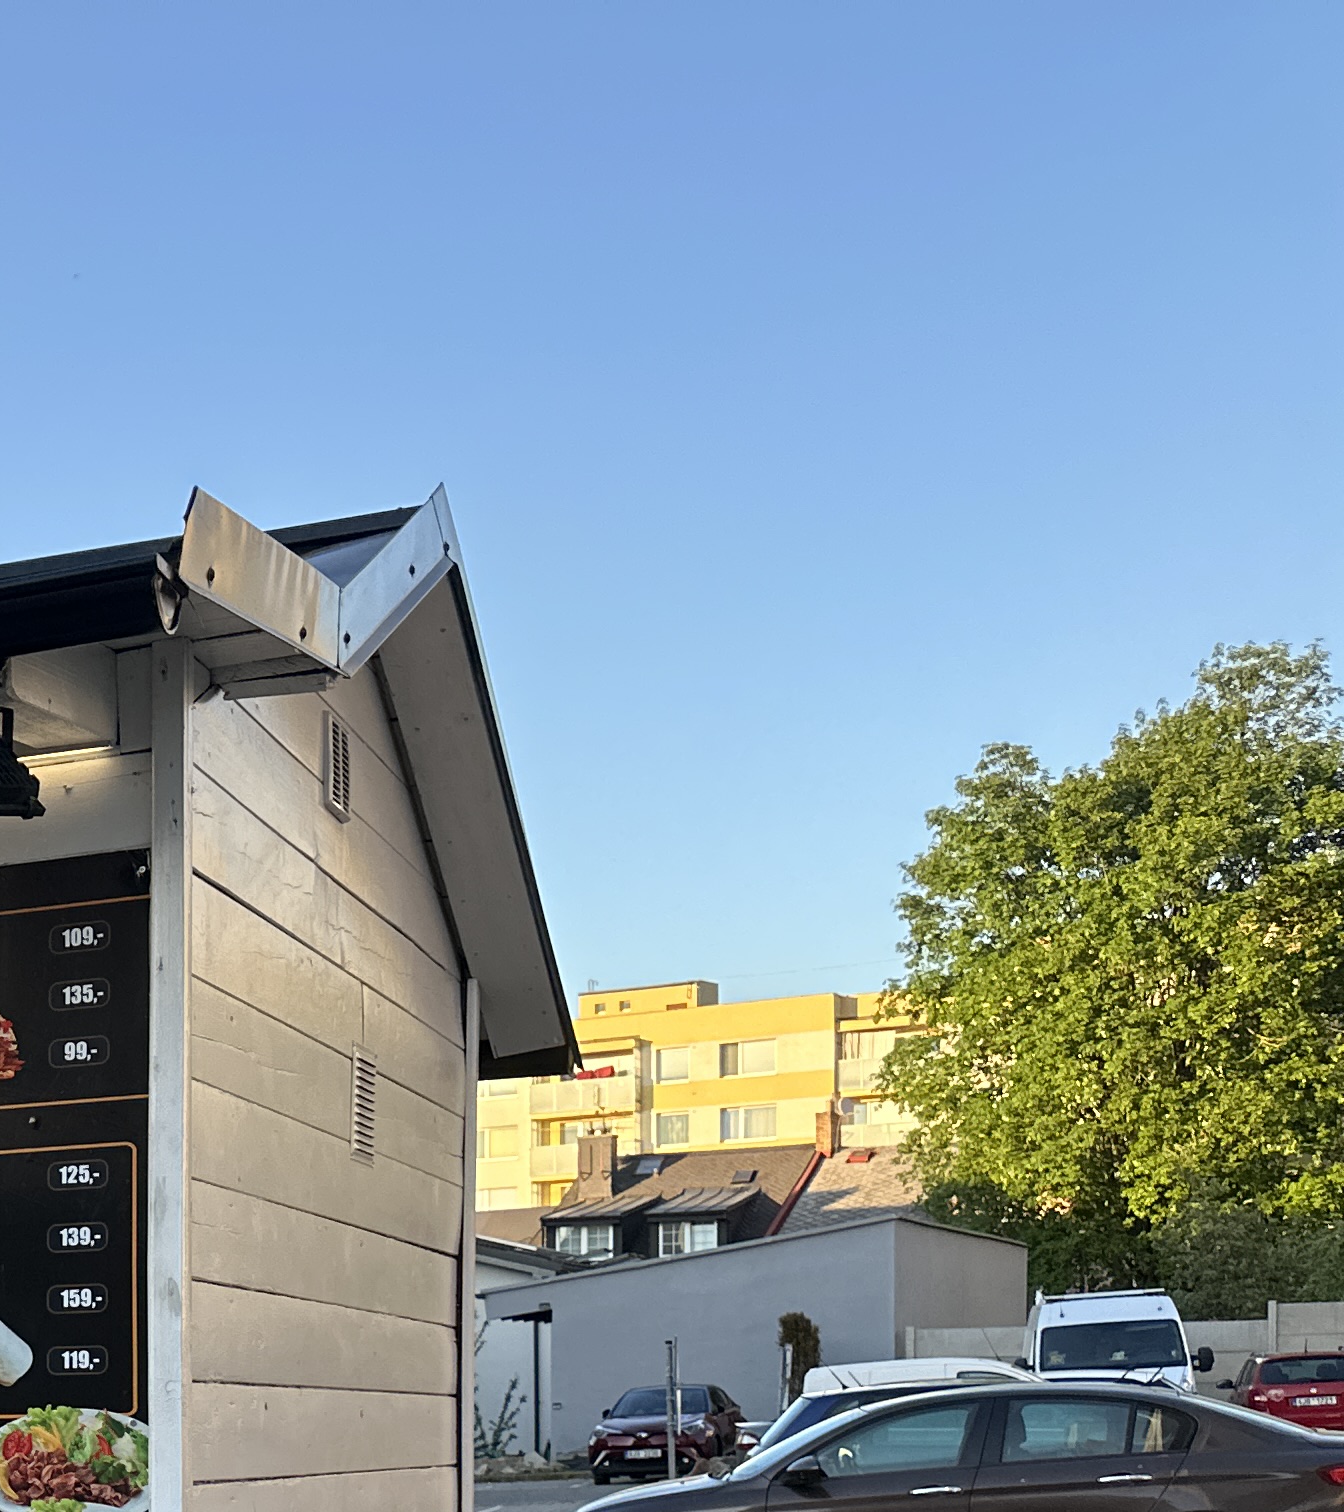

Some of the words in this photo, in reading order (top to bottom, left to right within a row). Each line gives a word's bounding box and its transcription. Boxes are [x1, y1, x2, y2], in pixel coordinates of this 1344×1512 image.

[62, 926, 104, 948] 109,-
[62, 984, 104, 1005] 135,-
[64, 1040, 98, 1062] 99,-
[58, 1164, 101, 1186] 125,-
[59, 1226, 102, 1248] 139,-
[60, 1288, 103, 1310] 159,-
[61, 1350, 101, 1371] 119,-
